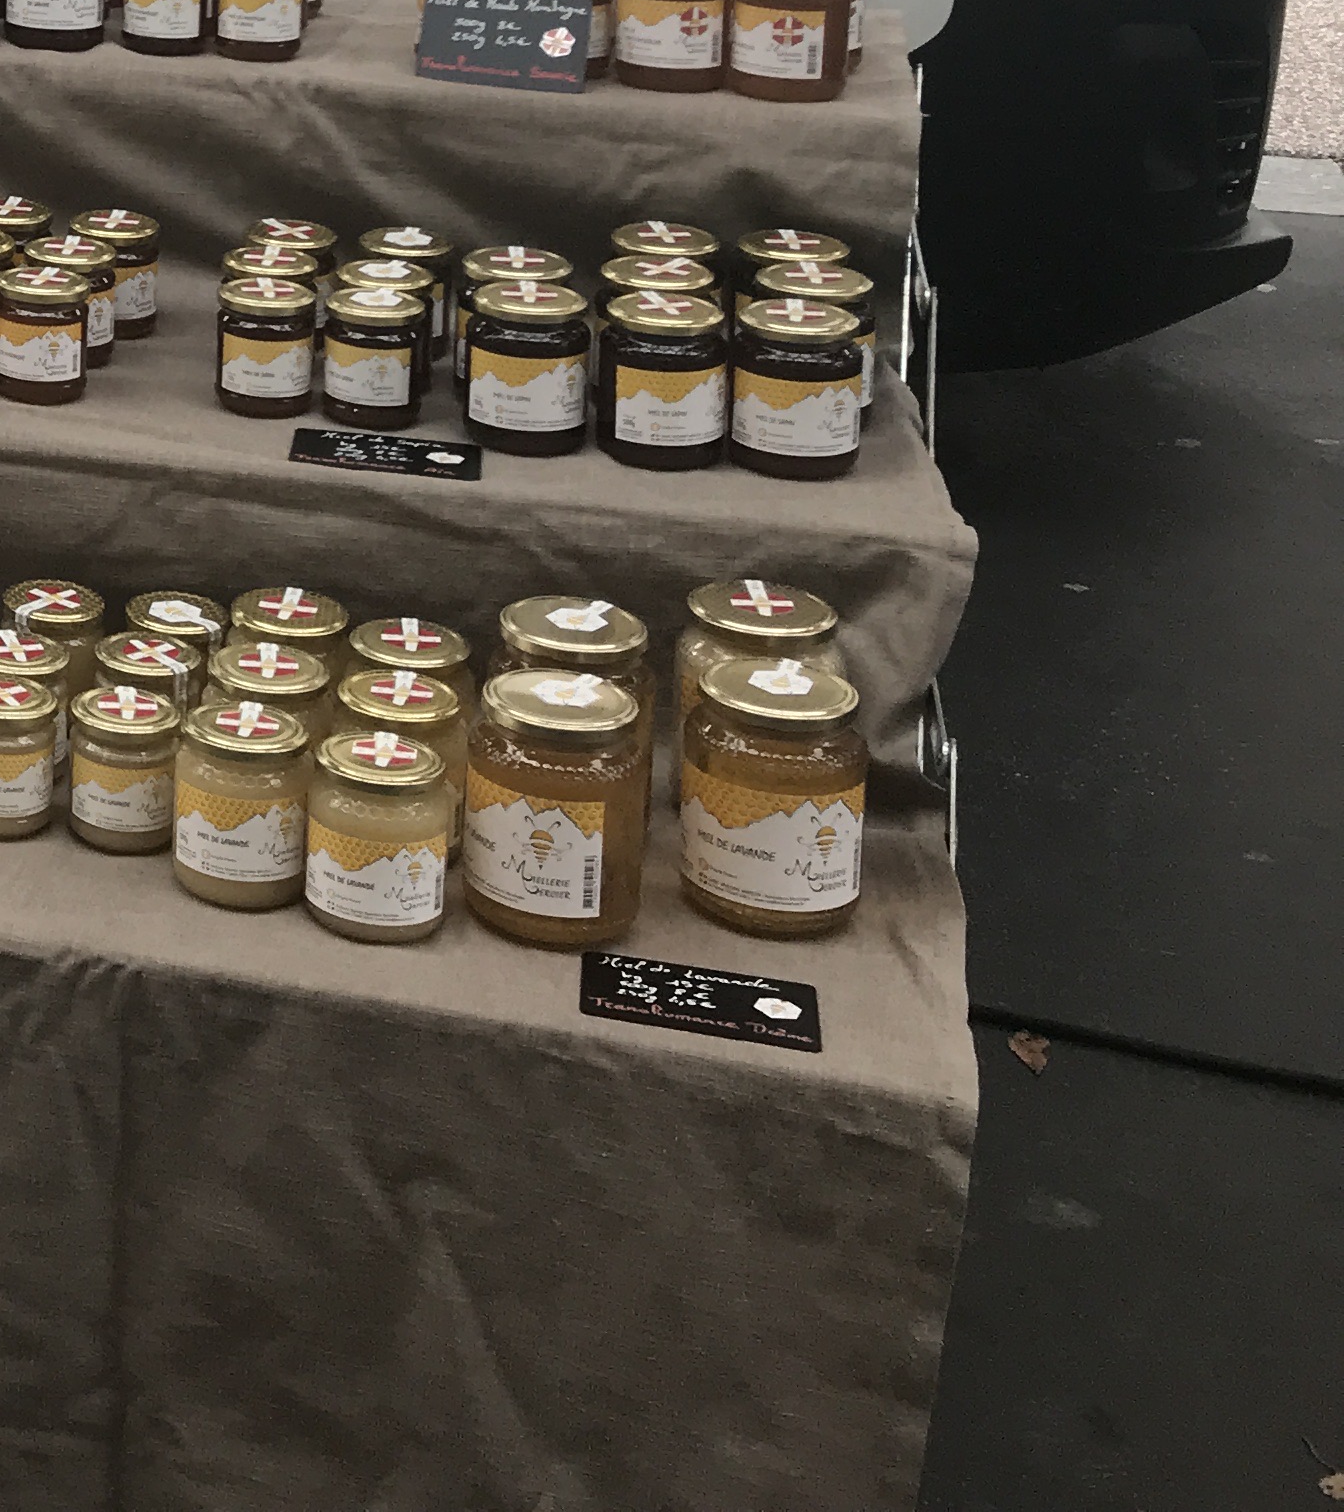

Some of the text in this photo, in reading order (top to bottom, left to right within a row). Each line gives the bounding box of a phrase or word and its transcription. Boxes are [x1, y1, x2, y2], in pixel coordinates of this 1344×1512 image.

[197, 829, 210, 841] MIEL
[211, 835, 220, 844] DE
[697, 829, 776, 862] MIEL DE LAVANDE
[323, 870, 337, 881] MIEL
[598, 956, 646, 970] Miel
[685, 970, 780, 992] Lavande
[621, 971, 642, 984] kg
[588, 996, 813, 1044] Transhumance Drôme
